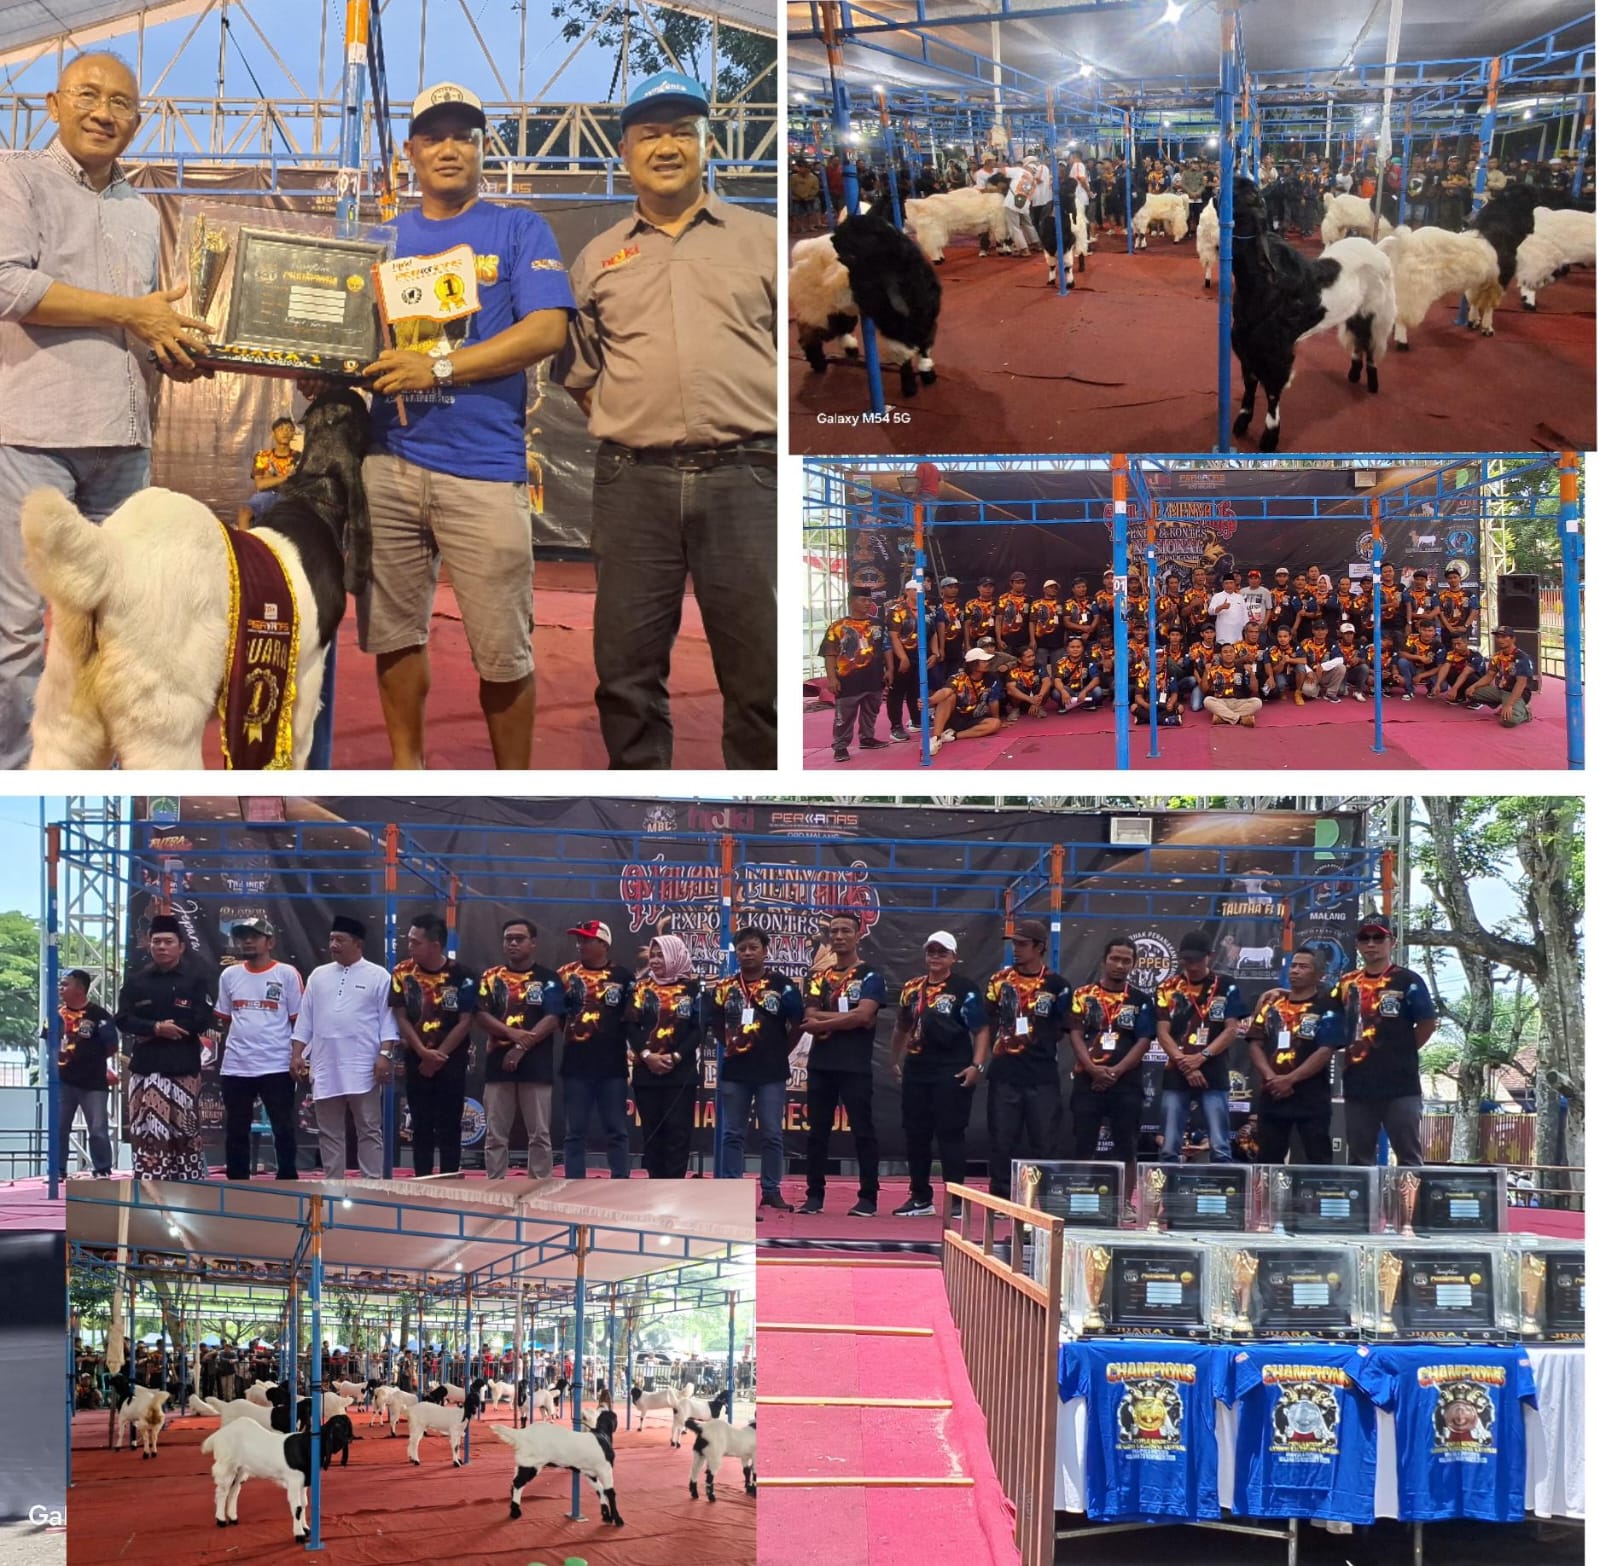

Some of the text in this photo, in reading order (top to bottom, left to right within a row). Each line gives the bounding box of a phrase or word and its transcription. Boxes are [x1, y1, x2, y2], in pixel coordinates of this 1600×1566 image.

[443, 279, 458, 298] 1
[1114, 580, 1126, 591] 01
[1222, 902, 1262, 916] TALITHA
[1309, 912, 1346, 921] MALANG
[1106, 1361, 1197, 1385] CHAMPIONS
[1417, 1364, 1507, 1389] CHAMPIONS
